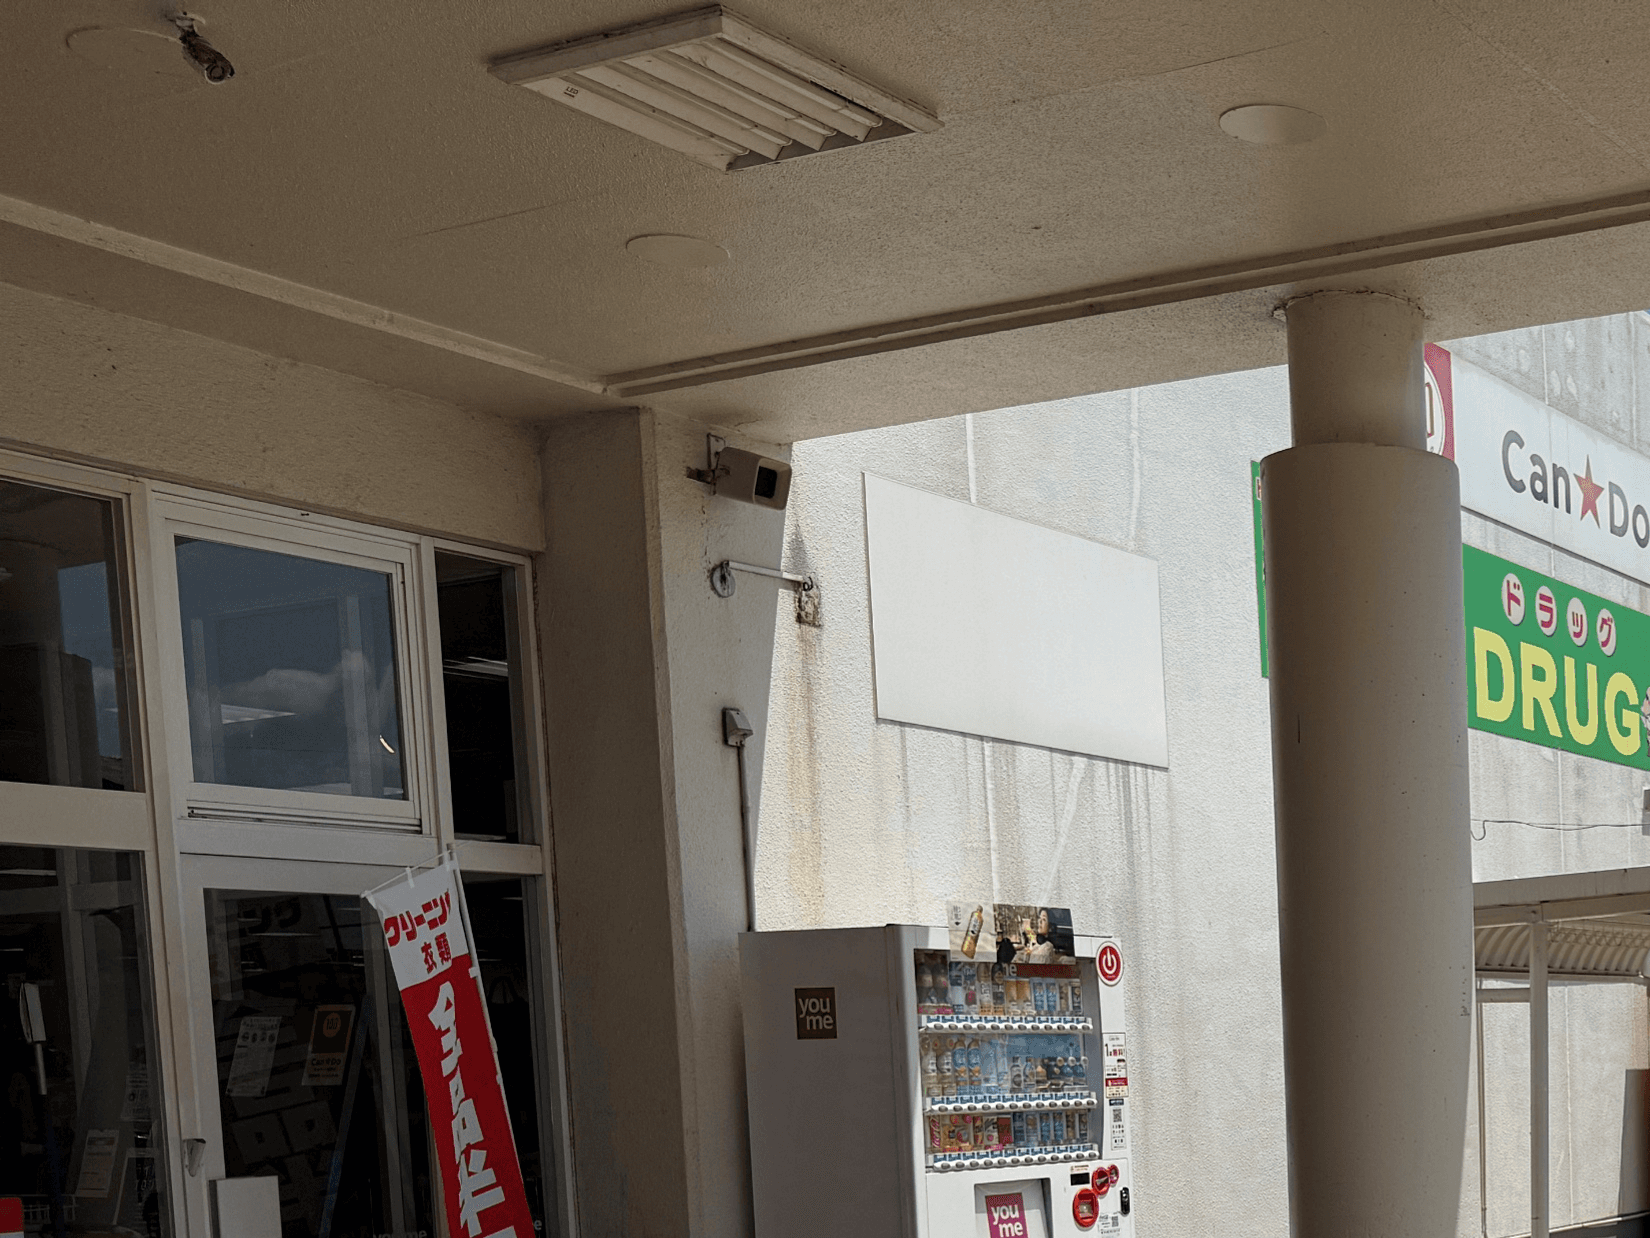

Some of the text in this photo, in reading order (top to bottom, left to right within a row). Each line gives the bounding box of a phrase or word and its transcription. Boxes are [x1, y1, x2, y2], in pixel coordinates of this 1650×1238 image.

[1501, 429, 1650, 550] Can Do
[1501, 573, 1617, 656] ドラッグ
[1473, 626, 1641, 757] DRUG
[383, 889, 452, 948] クリーニン
[420, 932, 452, 974] 衣類
[798, 995, 831, 1019] you
[805, 1013, 834, 1032] me
[991, 1204, 1020, 1232] you
